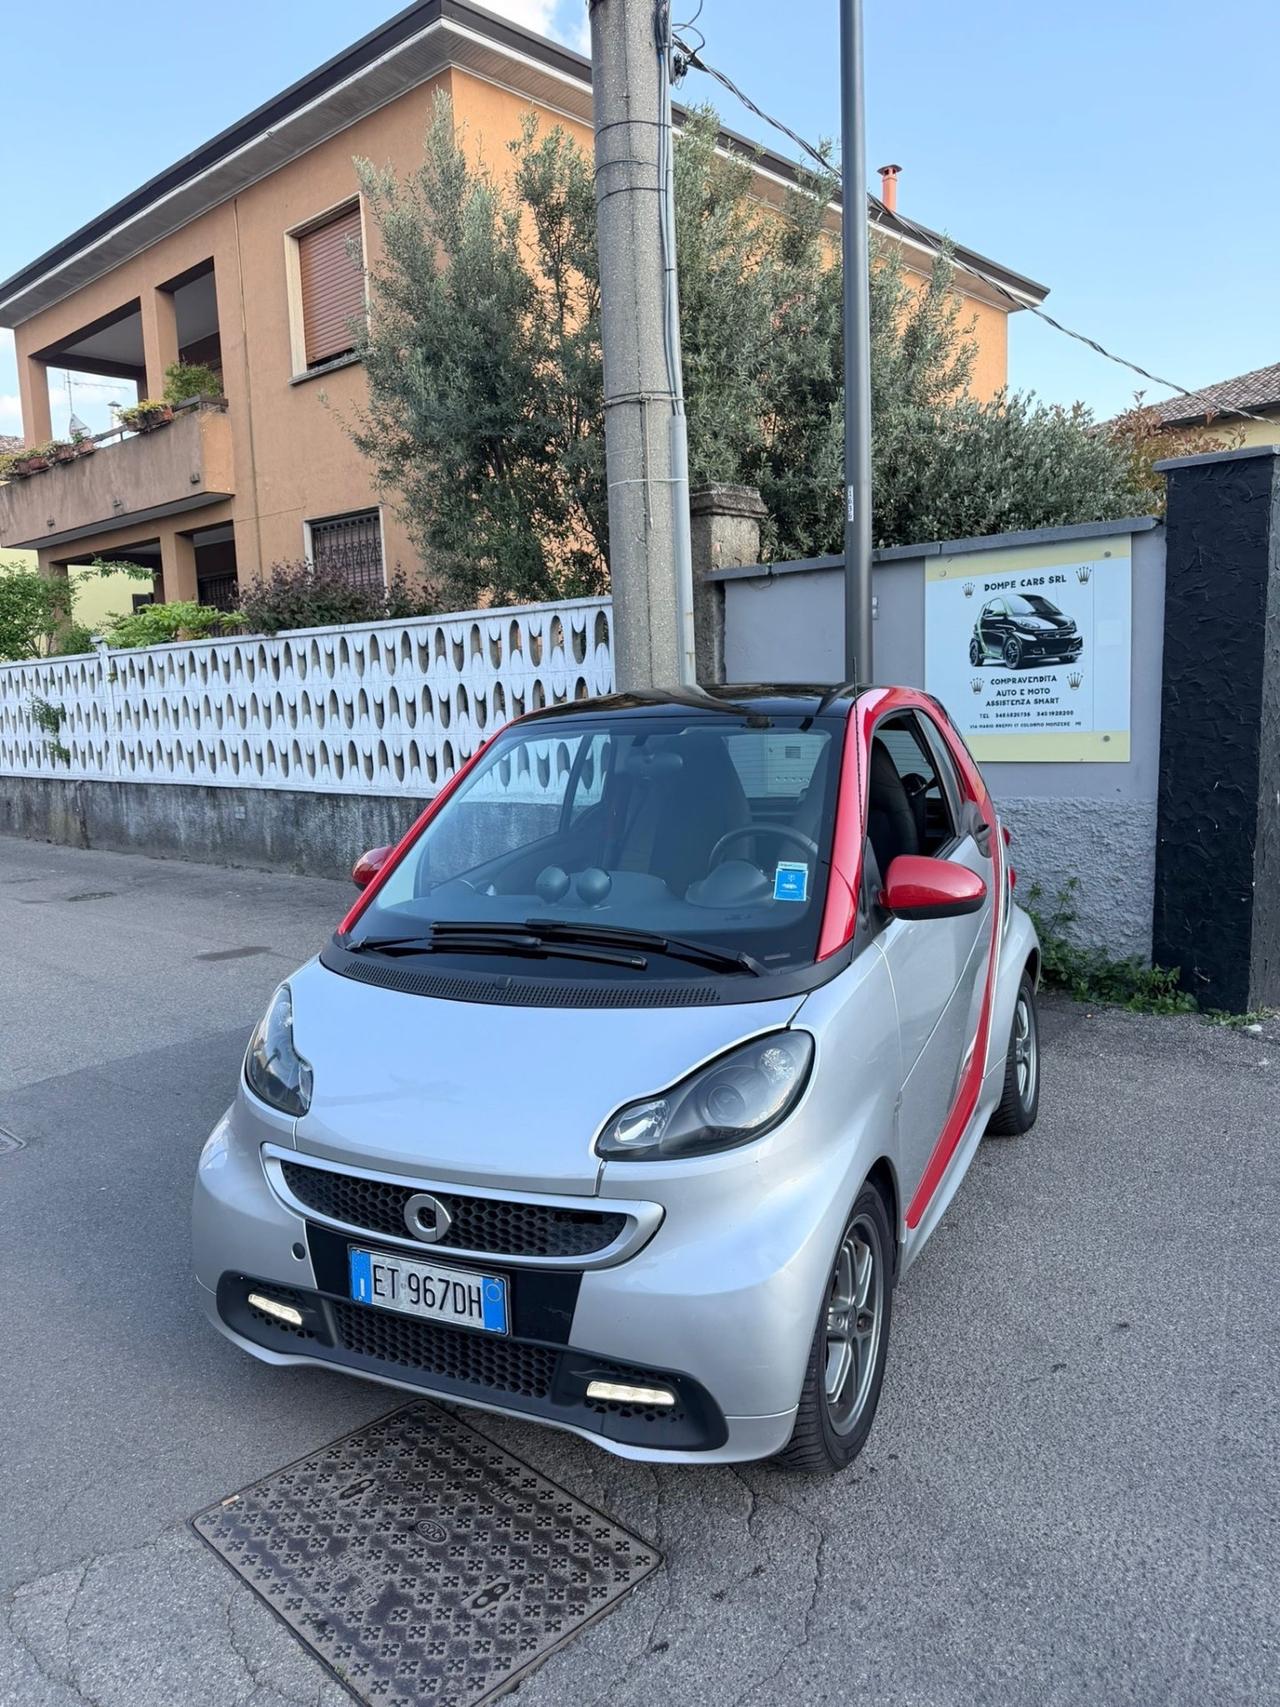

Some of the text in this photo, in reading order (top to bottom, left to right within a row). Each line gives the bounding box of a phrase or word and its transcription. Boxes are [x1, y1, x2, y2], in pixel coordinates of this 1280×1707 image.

[984, 575, 1067, 592] DOMPE CARS SRL
[990, 675, 1057, 685] COMPRAVENDITA
[996, 689, 1017, 697] AUTO
[985, 697, 1060, 707] ASSISTENZA SMART
[373, 1264, 399, 1299] ET
[408, 1273, 483, 1319] 967DH
